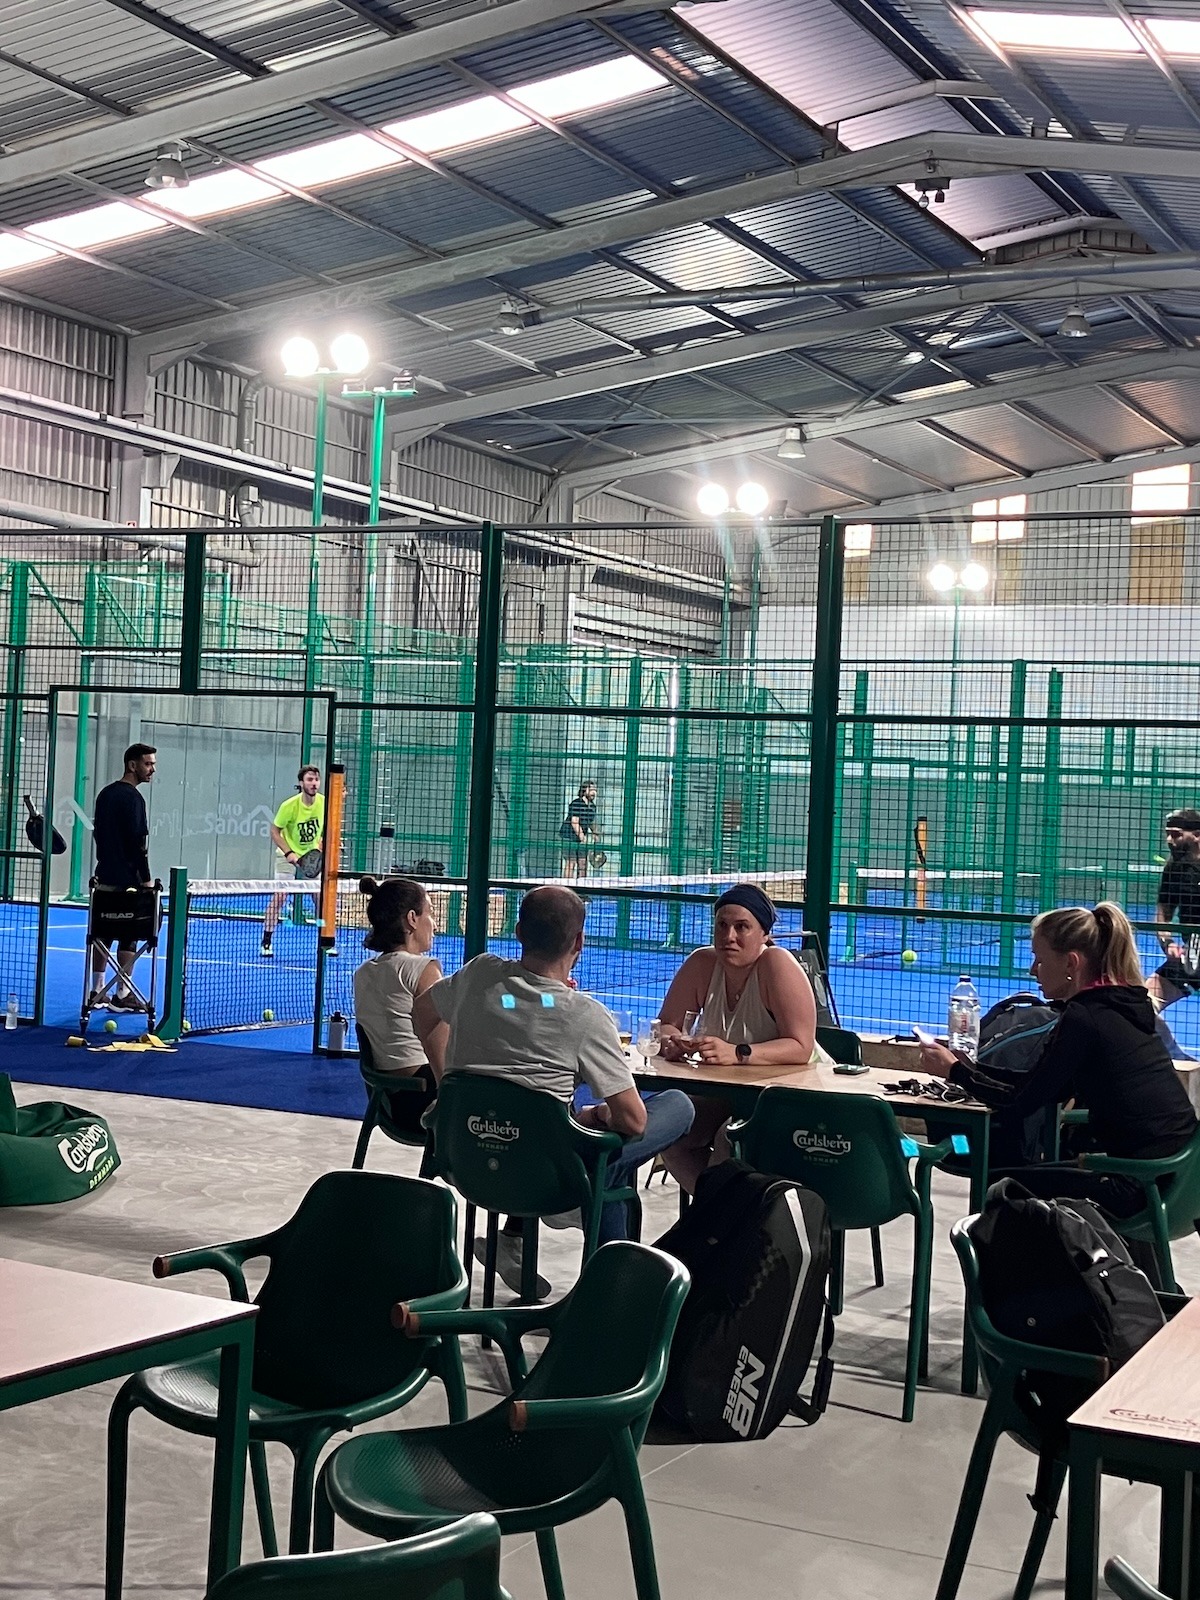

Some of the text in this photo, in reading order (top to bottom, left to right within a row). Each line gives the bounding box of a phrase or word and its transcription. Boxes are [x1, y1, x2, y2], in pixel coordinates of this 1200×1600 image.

[218, 803, 243, 816] IMO
[204, 812, 271, 838] Sandra
[467, 1115, 520, 1141] Carlsberg
[792, 1129, 851, 1155] Carlsberg
[57, 1123, 109, 1173] Carlsberg
[89, 1155, 115, 1190] DENMARK
[722, 1345, 749, 1424] ENEBE
[731, 1352, 766, 1437] NB
